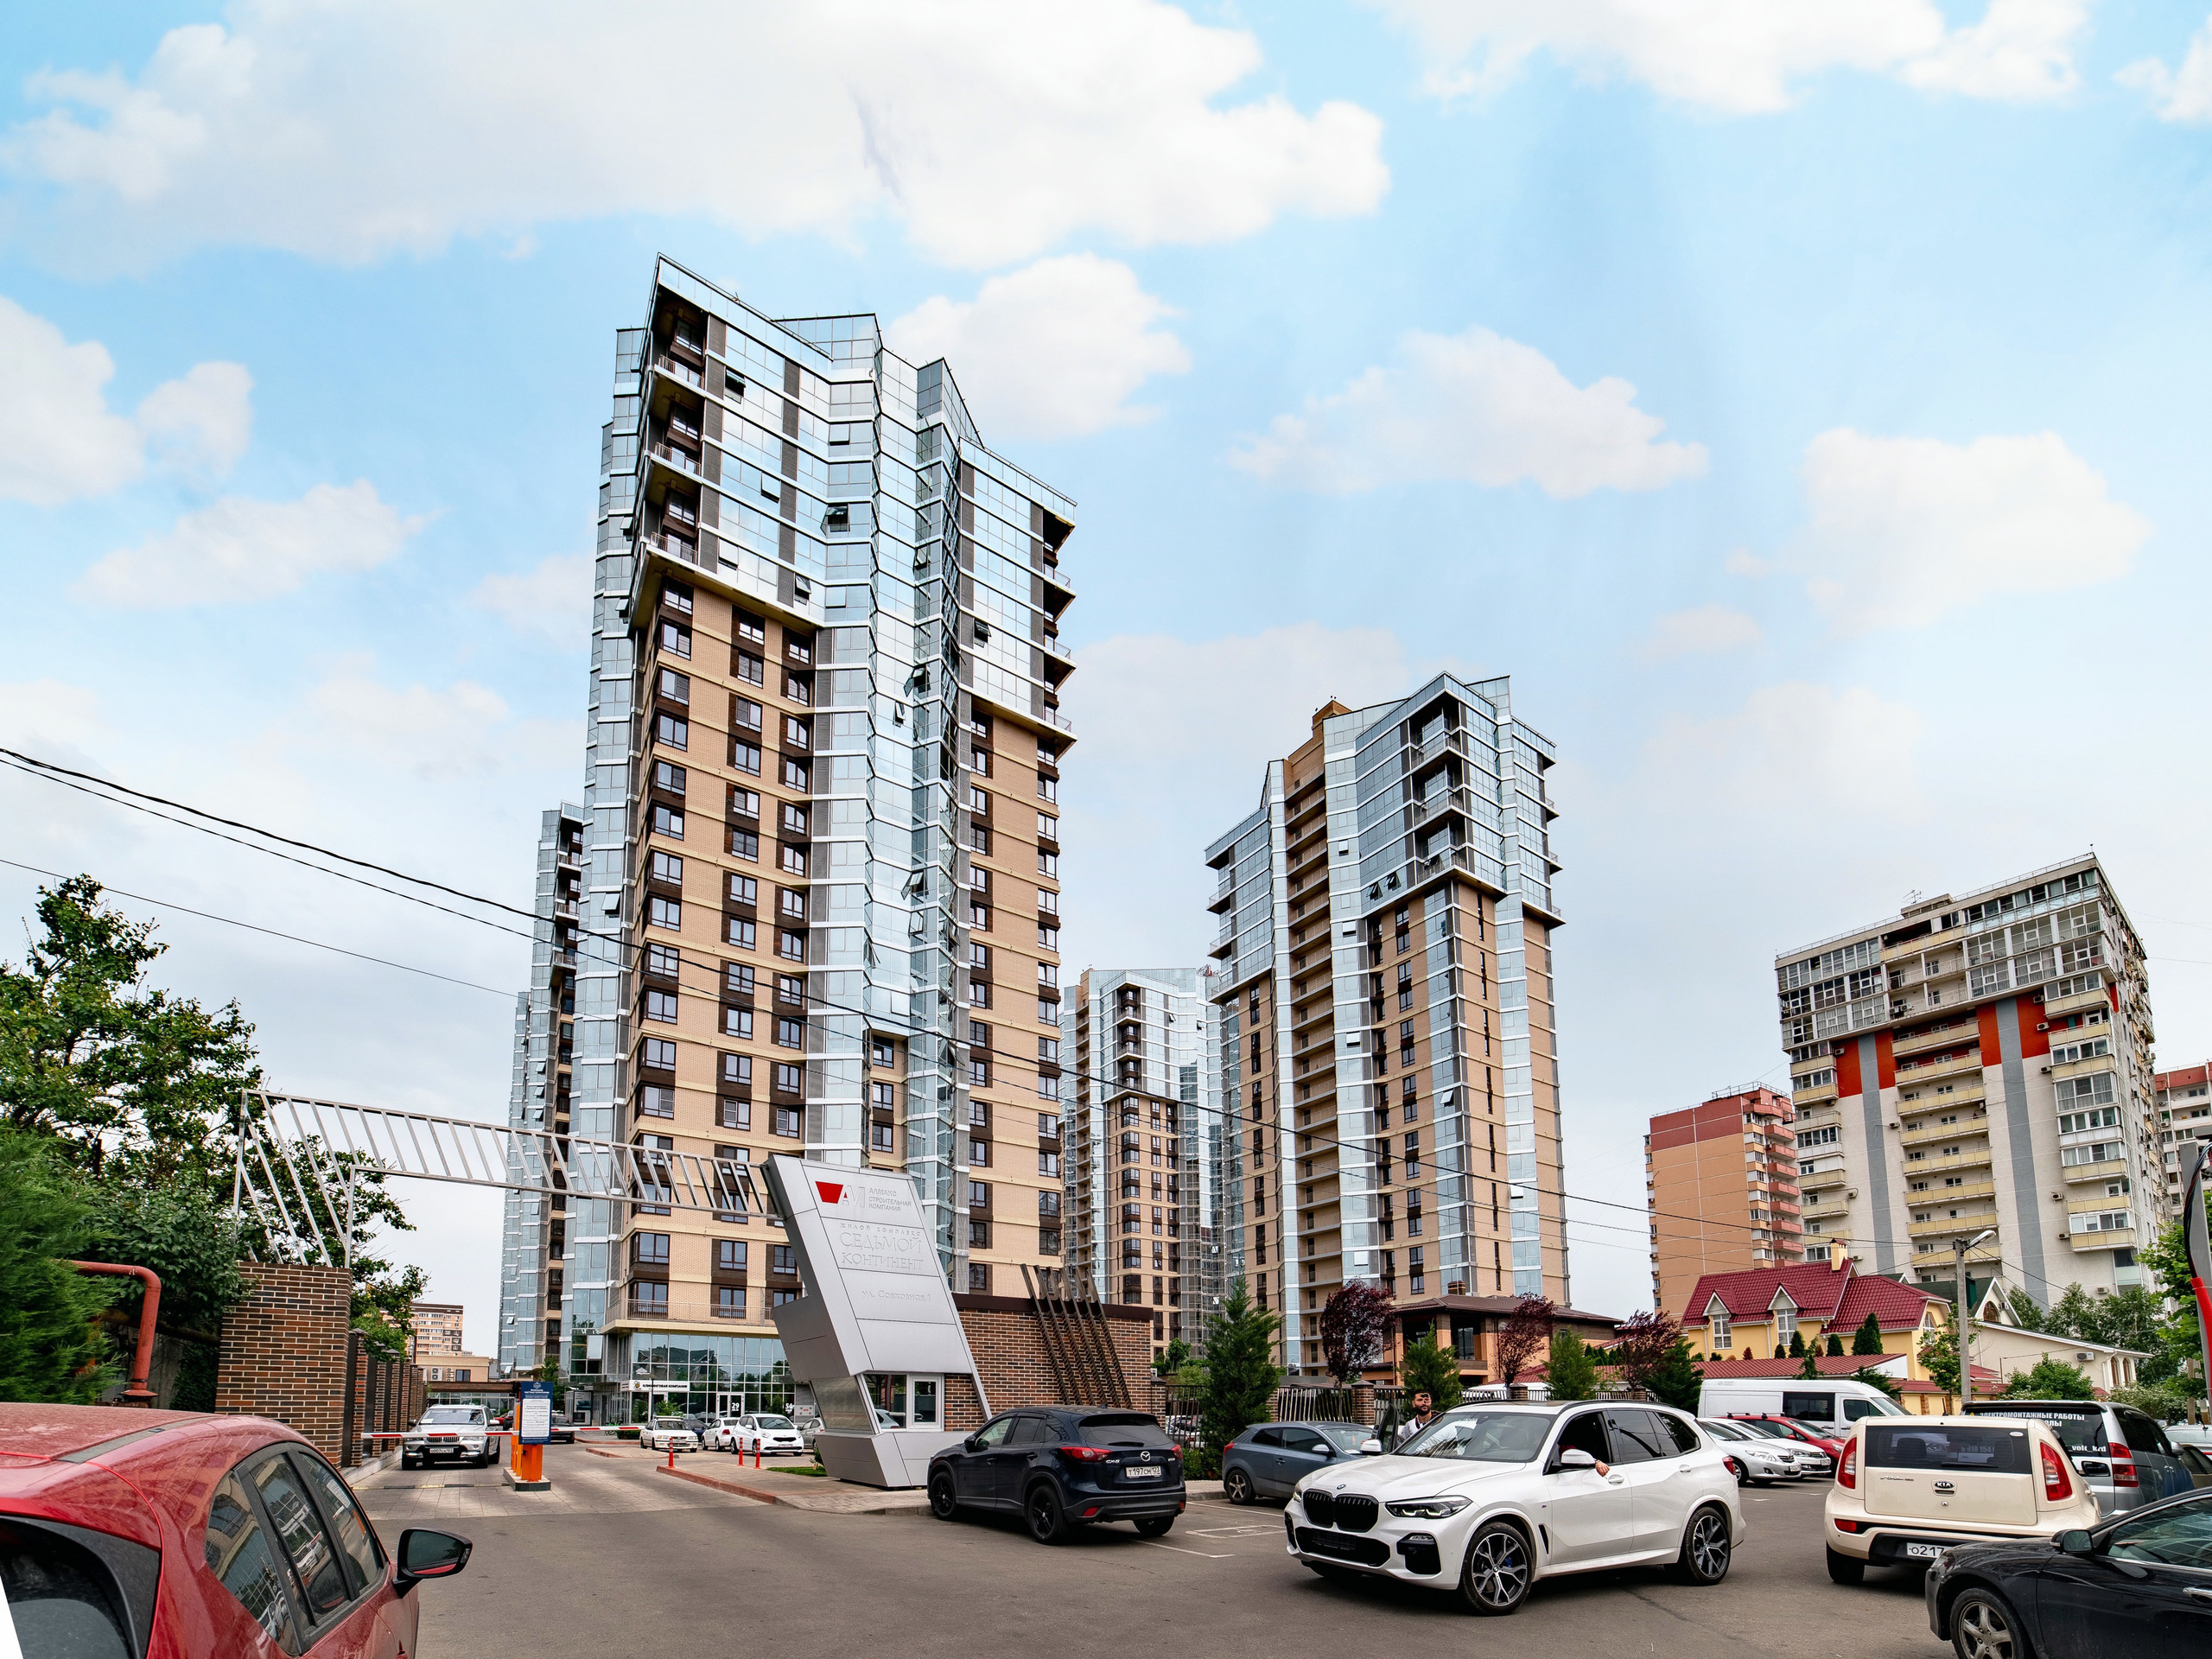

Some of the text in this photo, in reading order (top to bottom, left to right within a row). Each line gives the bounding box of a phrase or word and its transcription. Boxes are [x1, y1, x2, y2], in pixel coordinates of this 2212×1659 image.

[868, 1196, 912, 1207] СТРОИТЕЛЬНАЯ
[868, 1203, 901, 1212] КОМПАНИЯ
[840, 1231, 922, 1254] СЕДЬМОЙ
[841, 1252, 924, 1270] КОНТИНЕНТ
[2053, 1412, 2085, 1421] РАБОТЫ
[1910, 1545, 1945, 1556] О217
